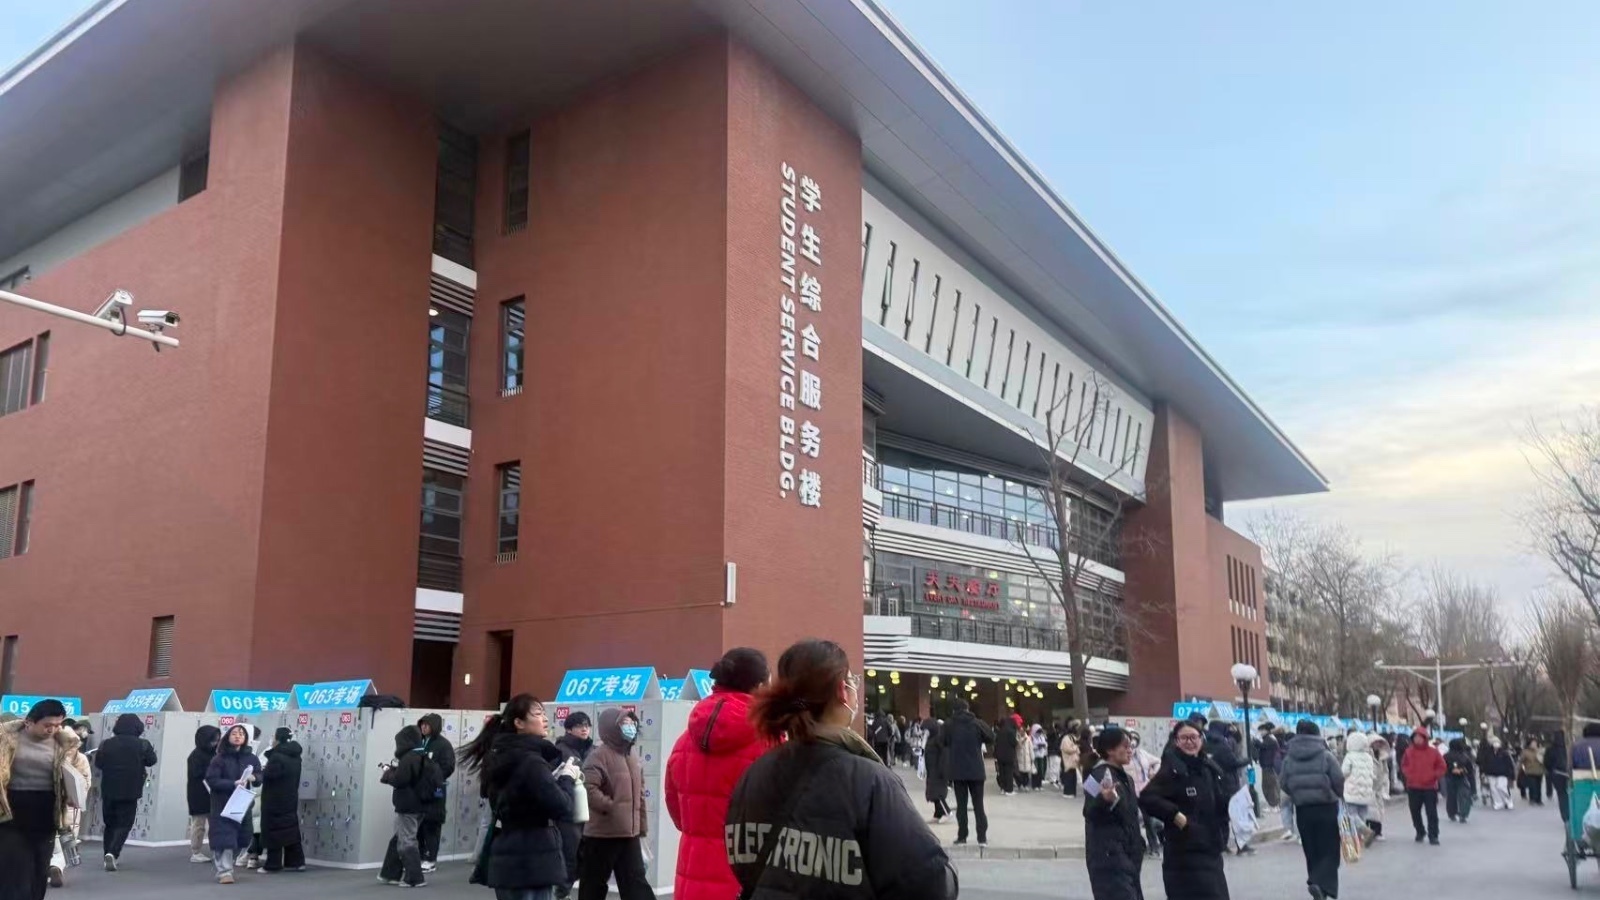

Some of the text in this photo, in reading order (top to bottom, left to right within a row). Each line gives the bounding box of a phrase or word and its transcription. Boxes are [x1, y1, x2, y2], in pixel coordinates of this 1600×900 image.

[779, 161, 796, 499] STUDENT SERVICE BLDG.
[799, 175, 822, 507] 学生综合服务楼
[308, 685, 361, 705] 063考场
[565, 674, 642, 697] 067考场
[221, 695, 288, 711] 060考场
